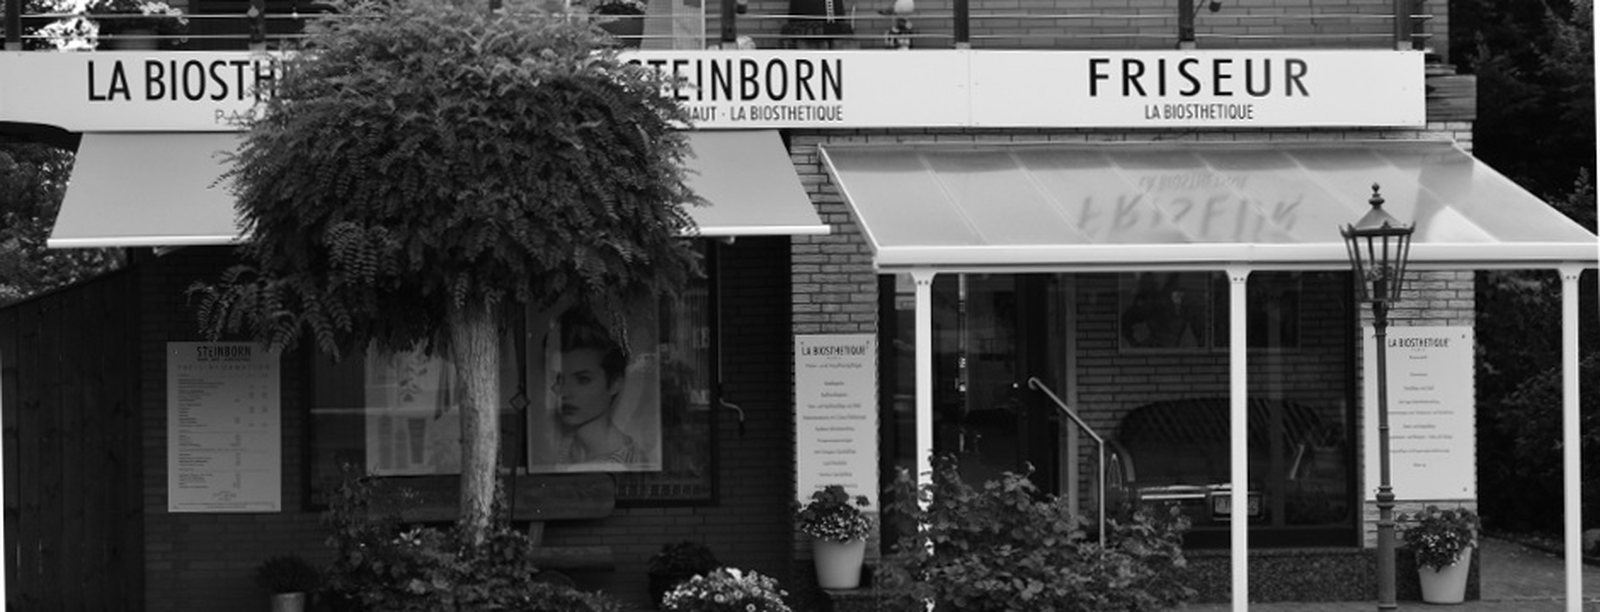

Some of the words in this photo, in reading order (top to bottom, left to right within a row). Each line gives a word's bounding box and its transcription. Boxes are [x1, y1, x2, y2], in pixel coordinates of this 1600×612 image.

[88, 60, 131, 101] LA
[145, 60, 277, 101] BIOSTH
[627, 58, 843, 101] TEINBORN
[1089, 58, 1310, 97] FRISEUR
[215, 109, 257, 125] PAR
[731, 106, 747, 121] LA
[750, 105, 843, 121] BIOSTHETIQUE
[1145, 104, 1161, 120] LA
[1164, 104, 1254, 120] BIOSTHETIQUE
[196, 345, 251, 358] STEINBORN
